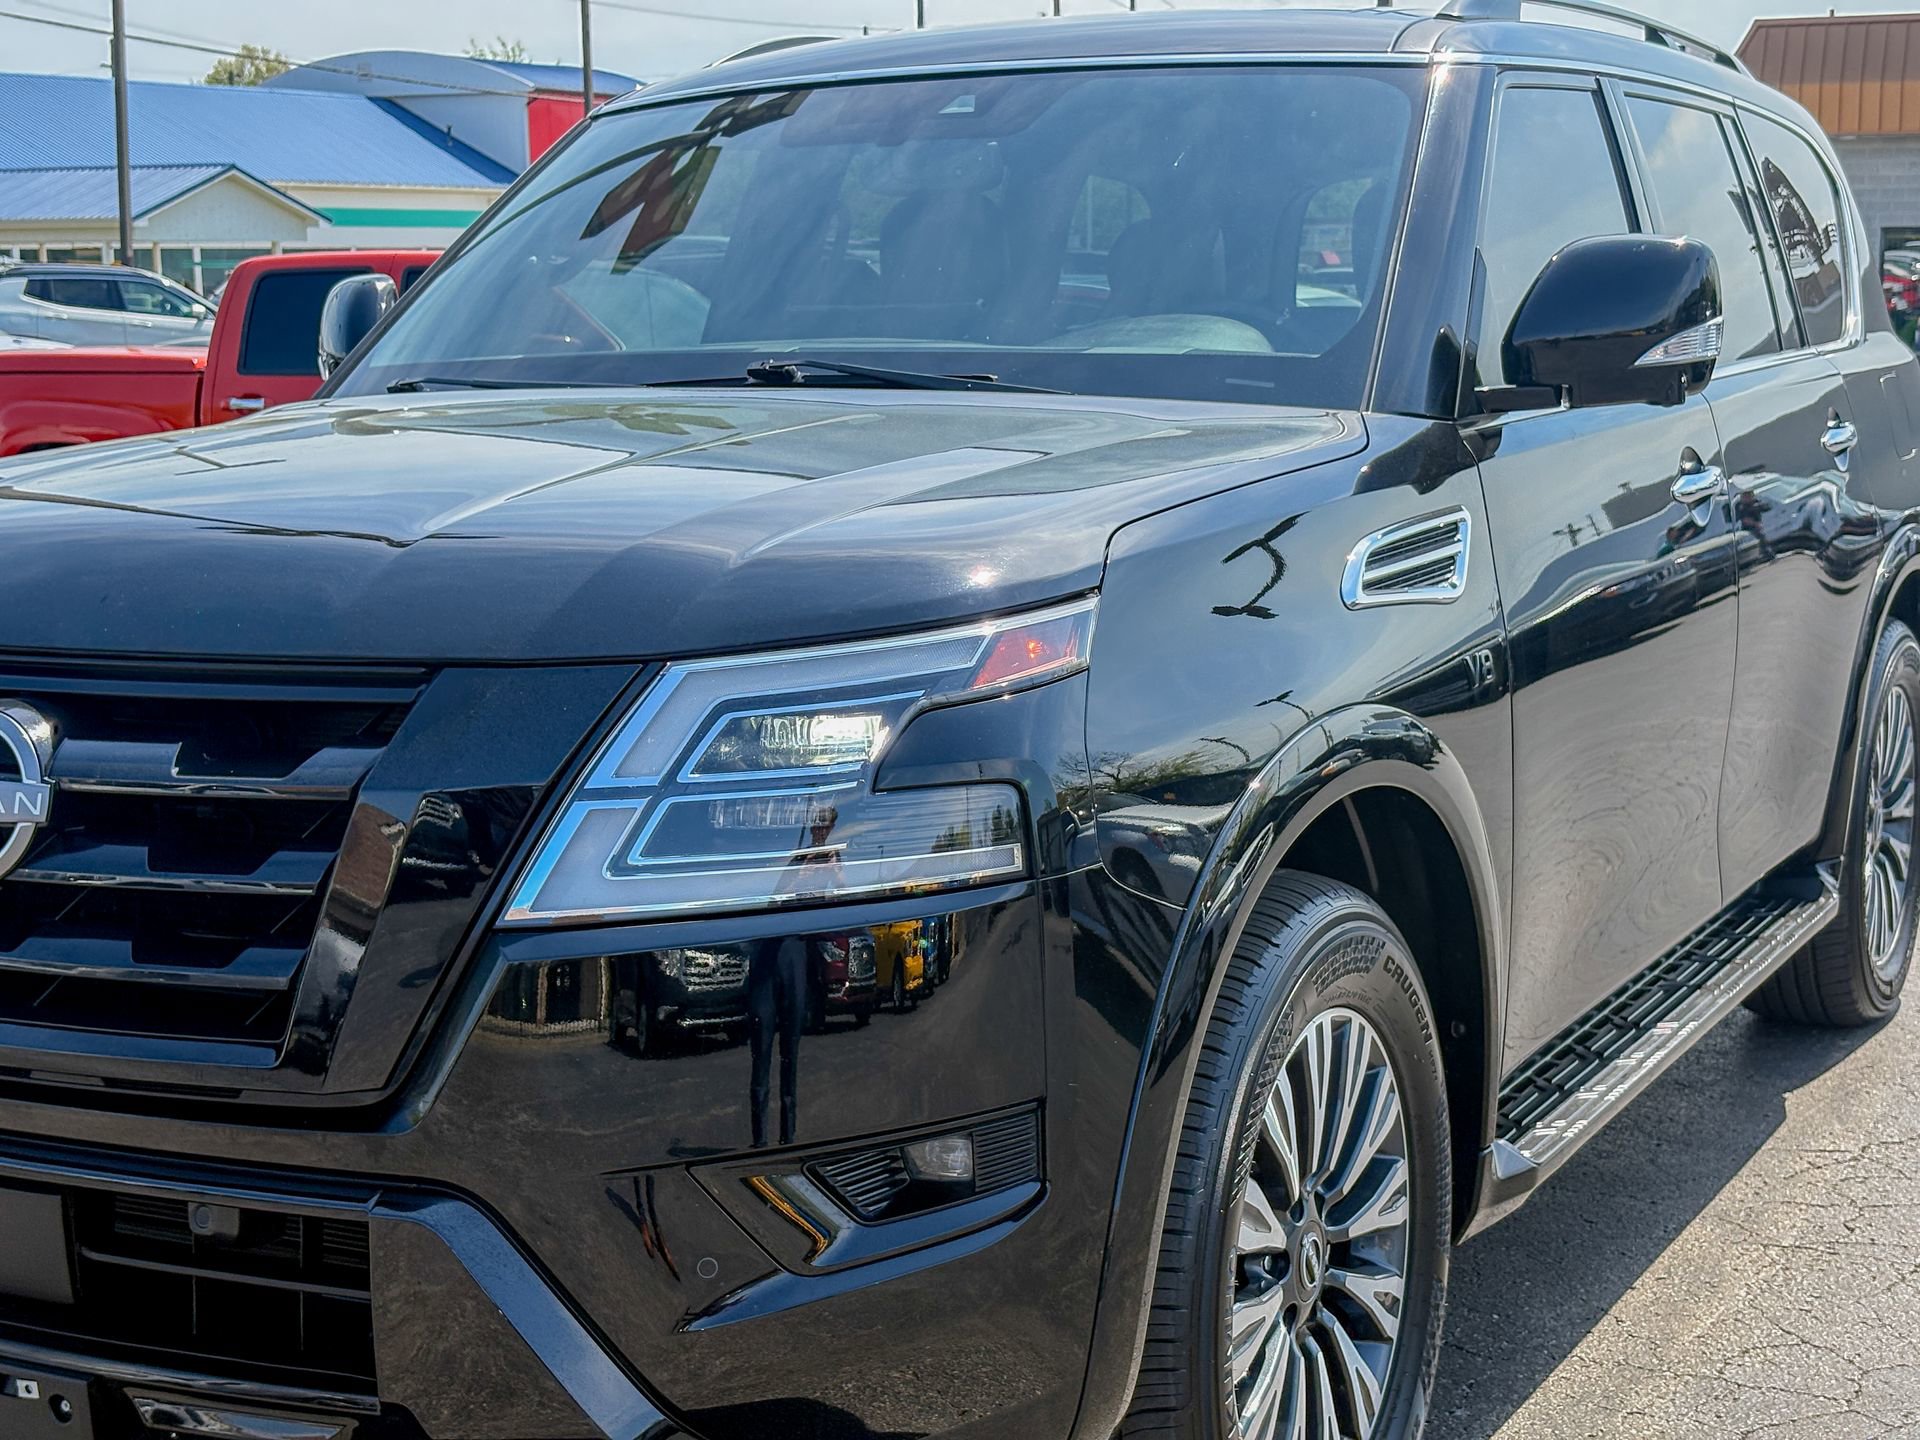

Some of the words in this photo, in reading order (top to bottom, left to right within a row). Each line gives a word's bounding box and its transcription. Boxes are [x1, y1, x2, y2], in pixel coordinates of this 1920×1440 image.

[1463, 649, 1496, 688] V8
[0, 791, 42, 815] N
[1382, 955, 1433, 1045] CRUGEN
